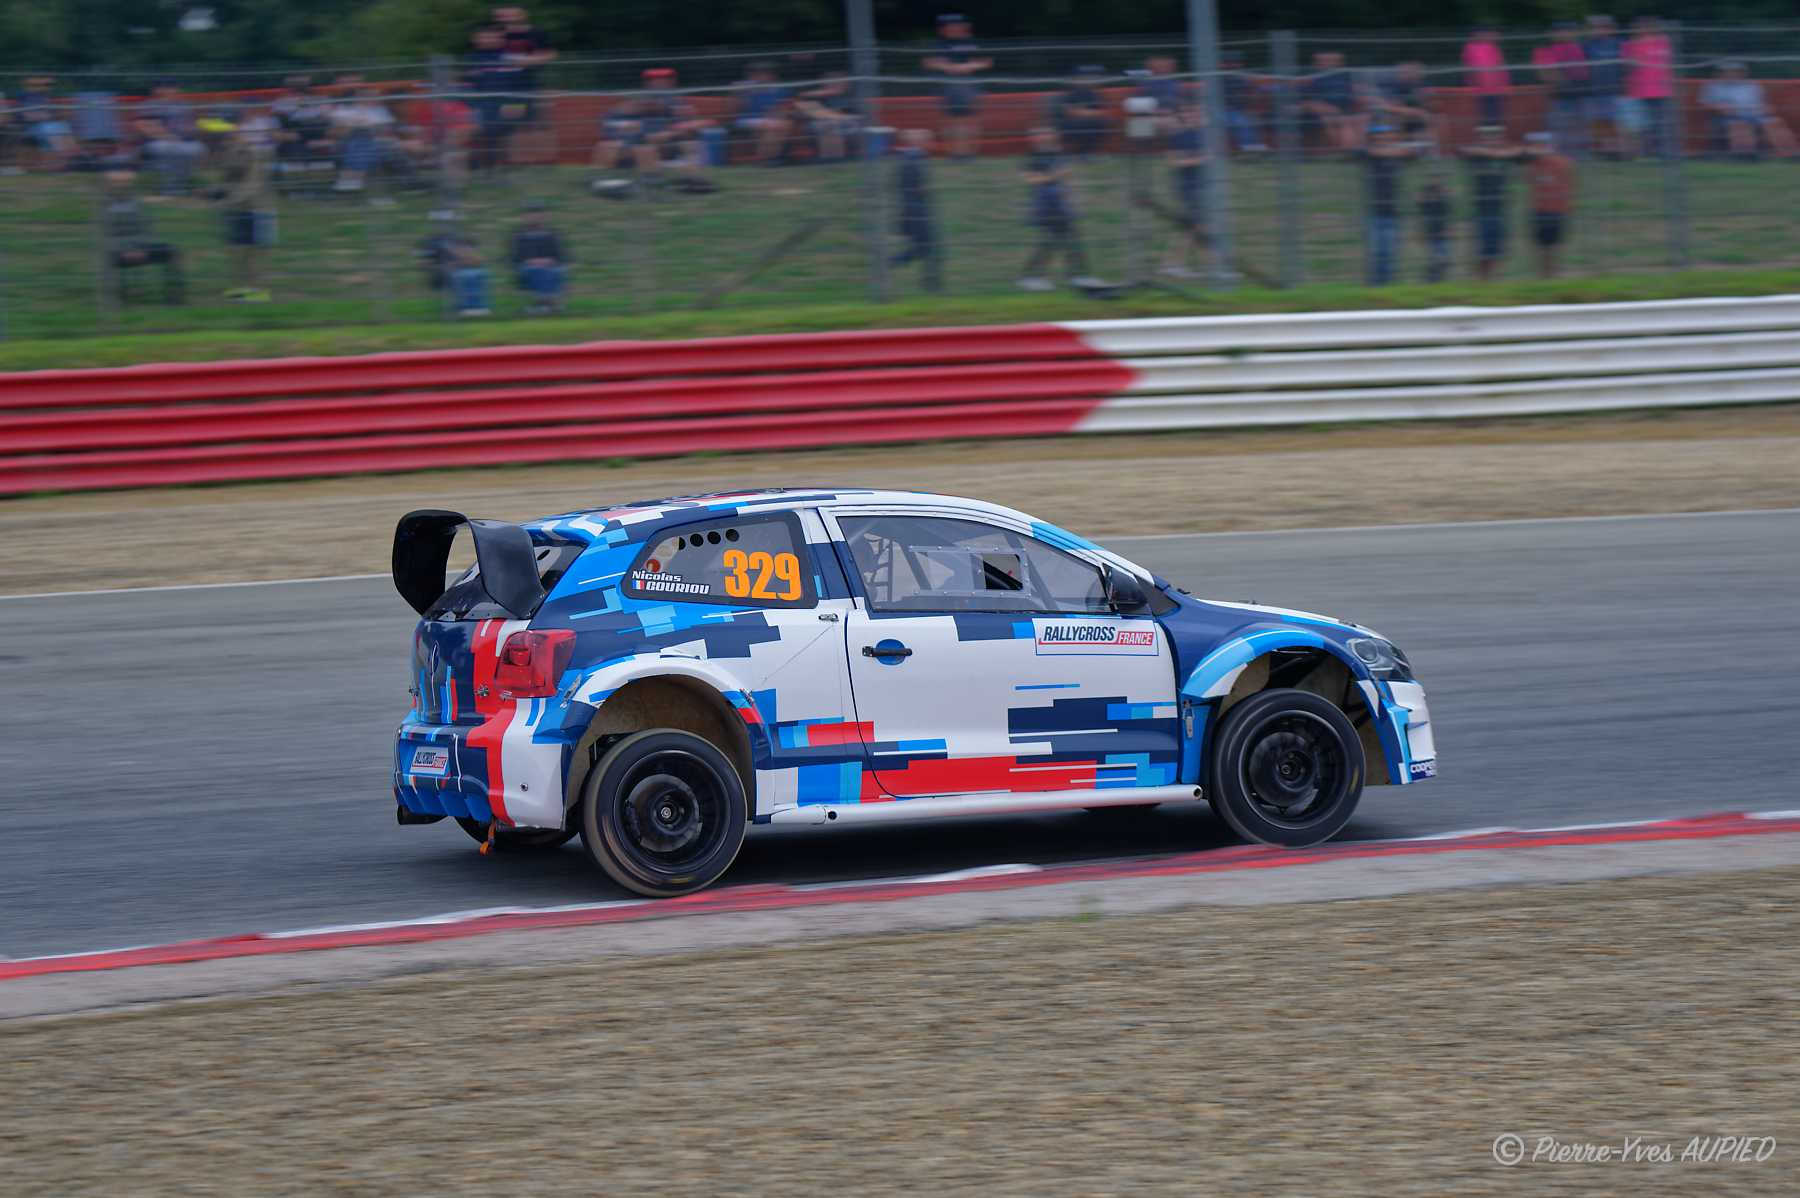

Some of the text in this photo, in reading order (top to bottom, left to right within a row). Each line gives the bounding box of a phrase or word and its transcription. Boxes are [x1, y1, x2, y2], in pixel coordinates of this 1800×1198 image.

[631, 570, 682, 582] Nicolas
[723, 549, 801, 600] 329
[1043, 626, 1152, 645] RALLYCROSS FRANCE
